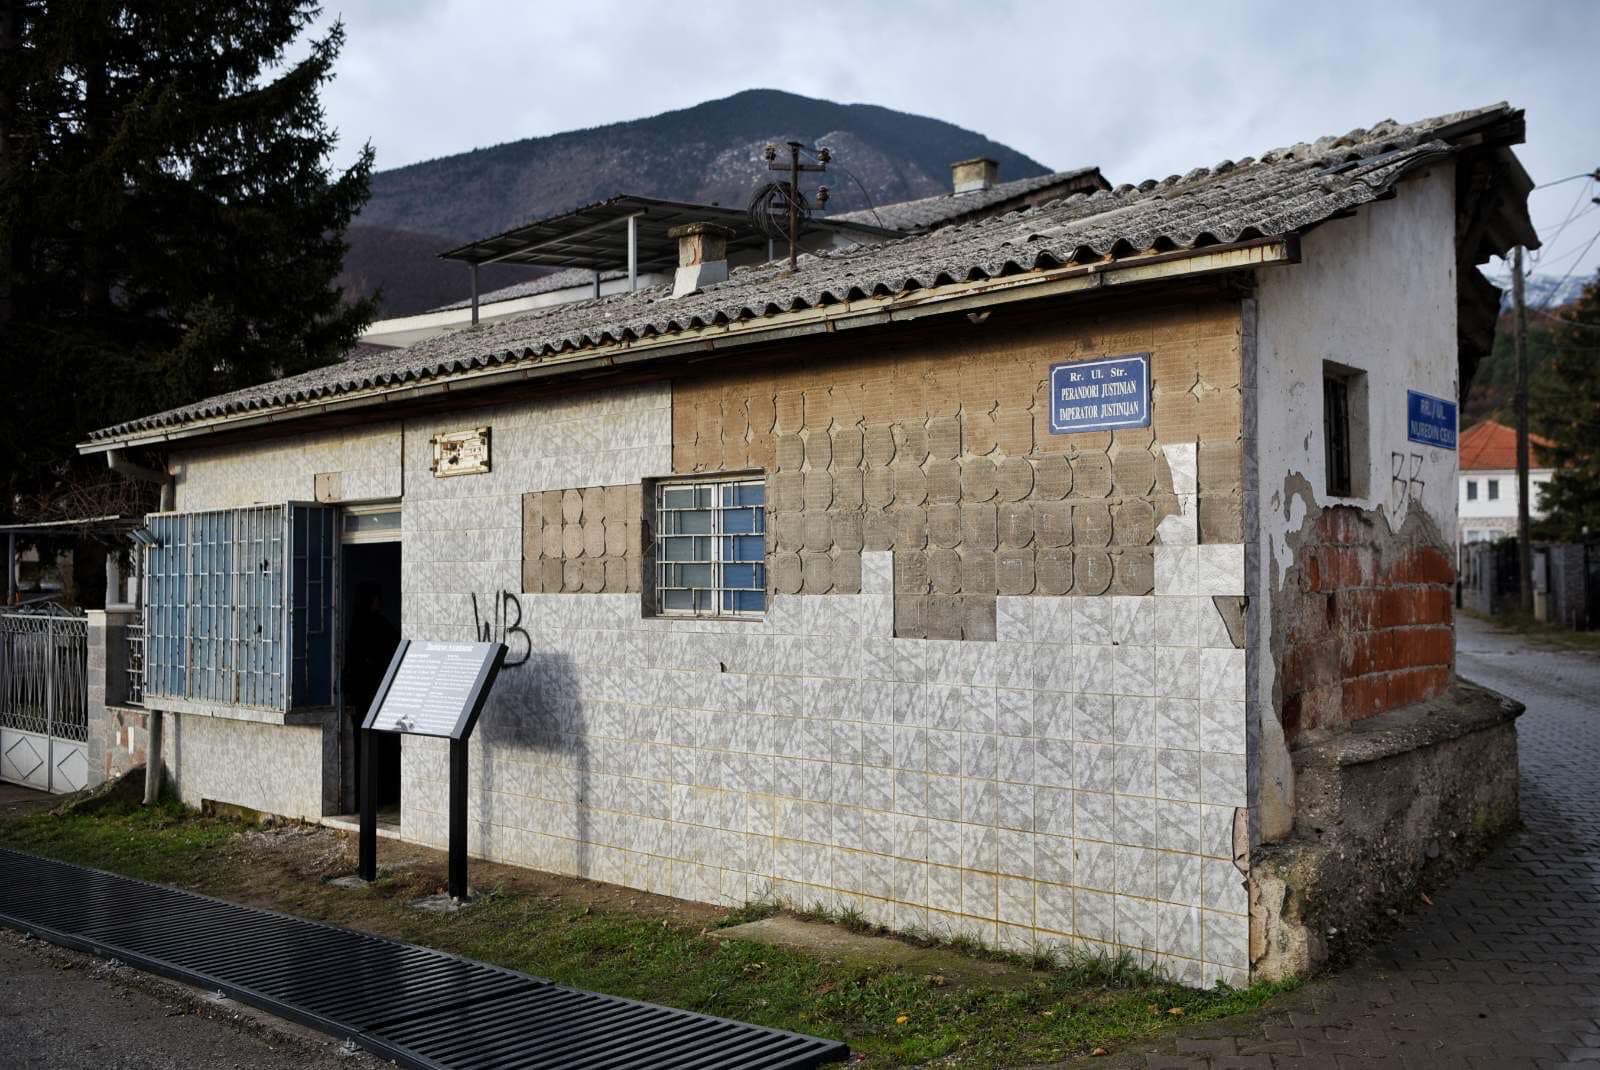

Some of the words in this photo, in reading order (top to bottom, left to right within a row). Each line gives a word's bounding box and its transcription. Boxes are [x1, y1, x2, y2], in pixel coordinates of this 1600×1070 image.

[1070, 372, 1084, 382] Rr.
[1110, 367, 1128, 378] Str.
[1061, 384, 1099, 401] PERANDORI
[1101, 380, 1137, 399] JUSTINIAN
[1059, 405, 1099, 421] IMPERATOR
[1101, 401, 1139, 419] JUSTINIJAN
